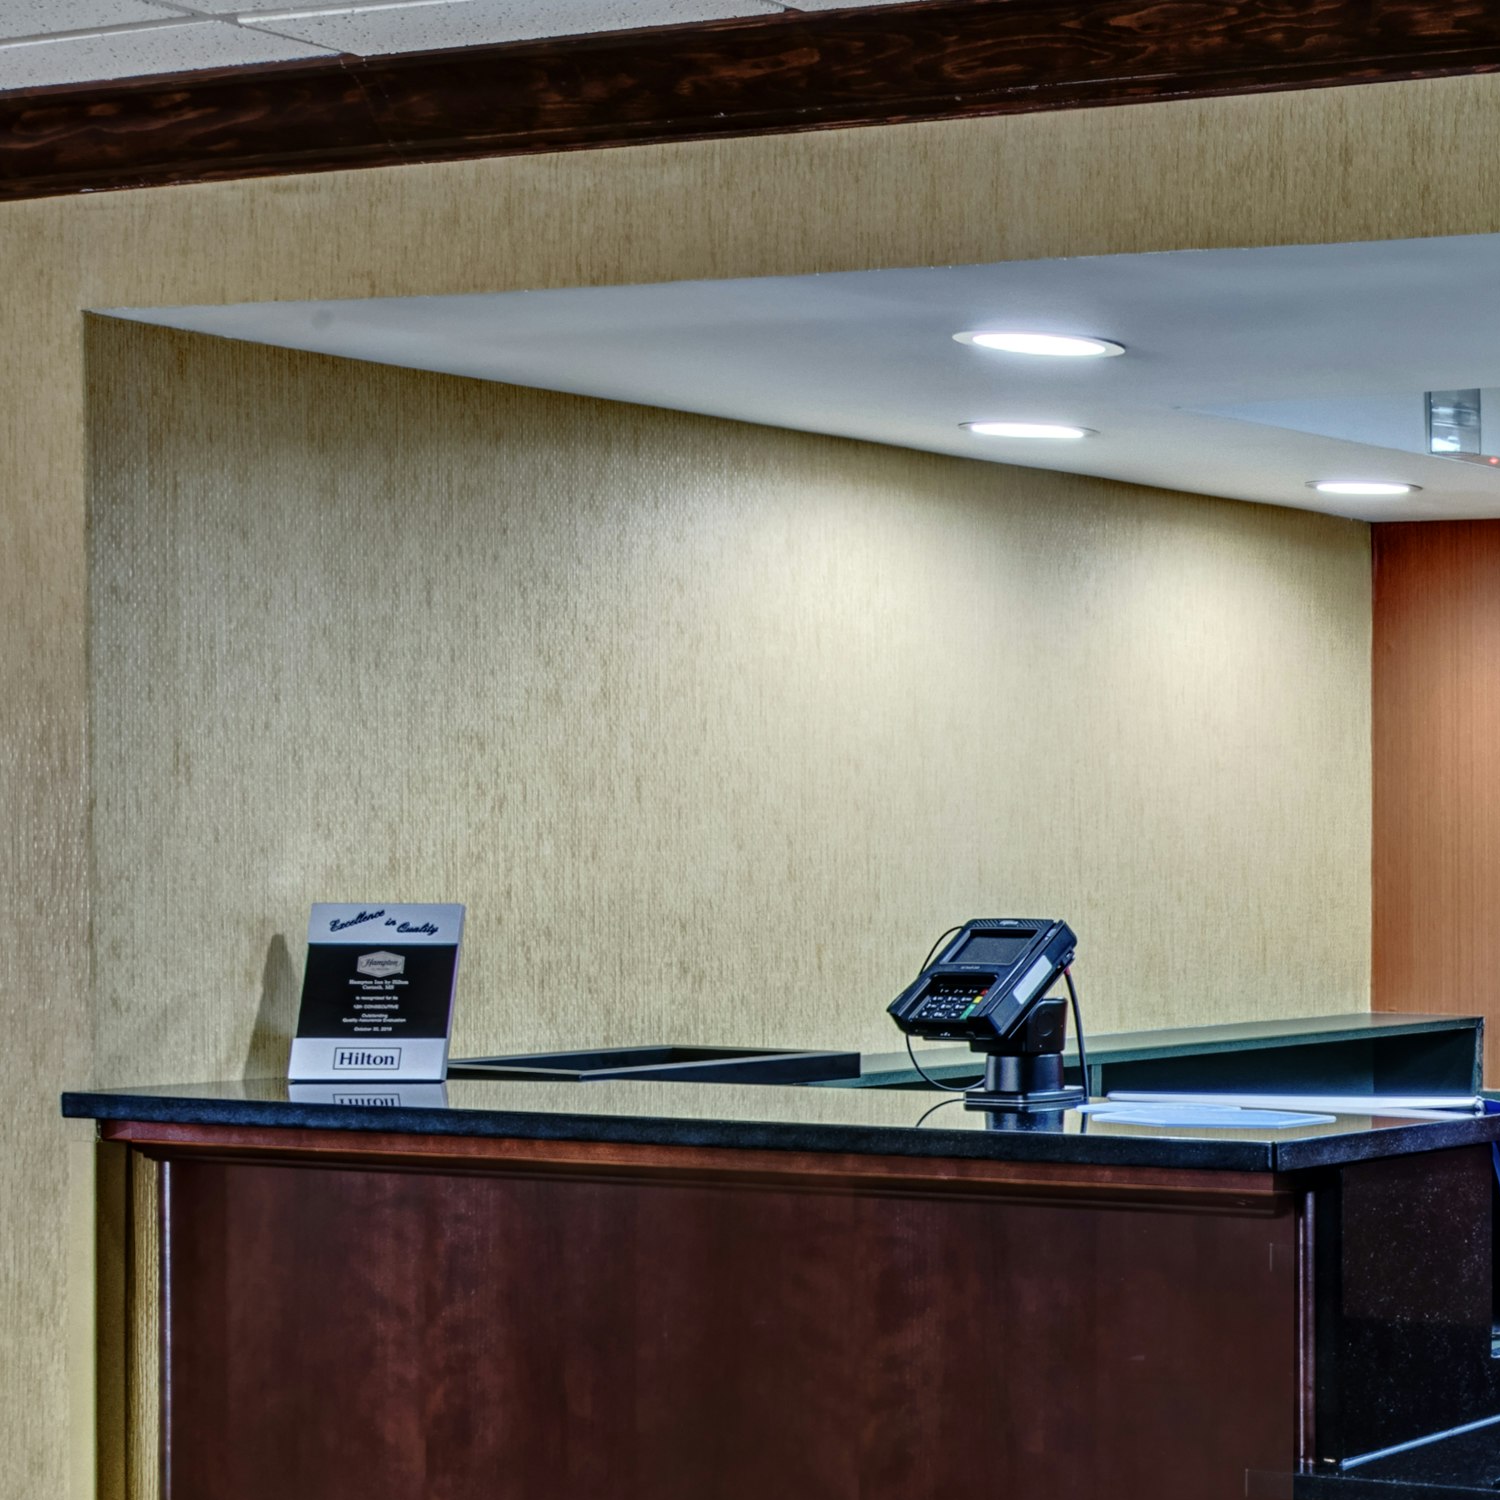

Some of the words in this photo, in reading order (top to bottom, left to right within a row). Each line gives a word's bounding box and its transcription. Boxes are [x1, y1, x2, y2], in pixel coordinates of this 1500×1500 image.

[330, 909, 385, 932] Excellence
[396, 921, 439, 936] Quality
[339, 1052, 395, 1066] Hilton
